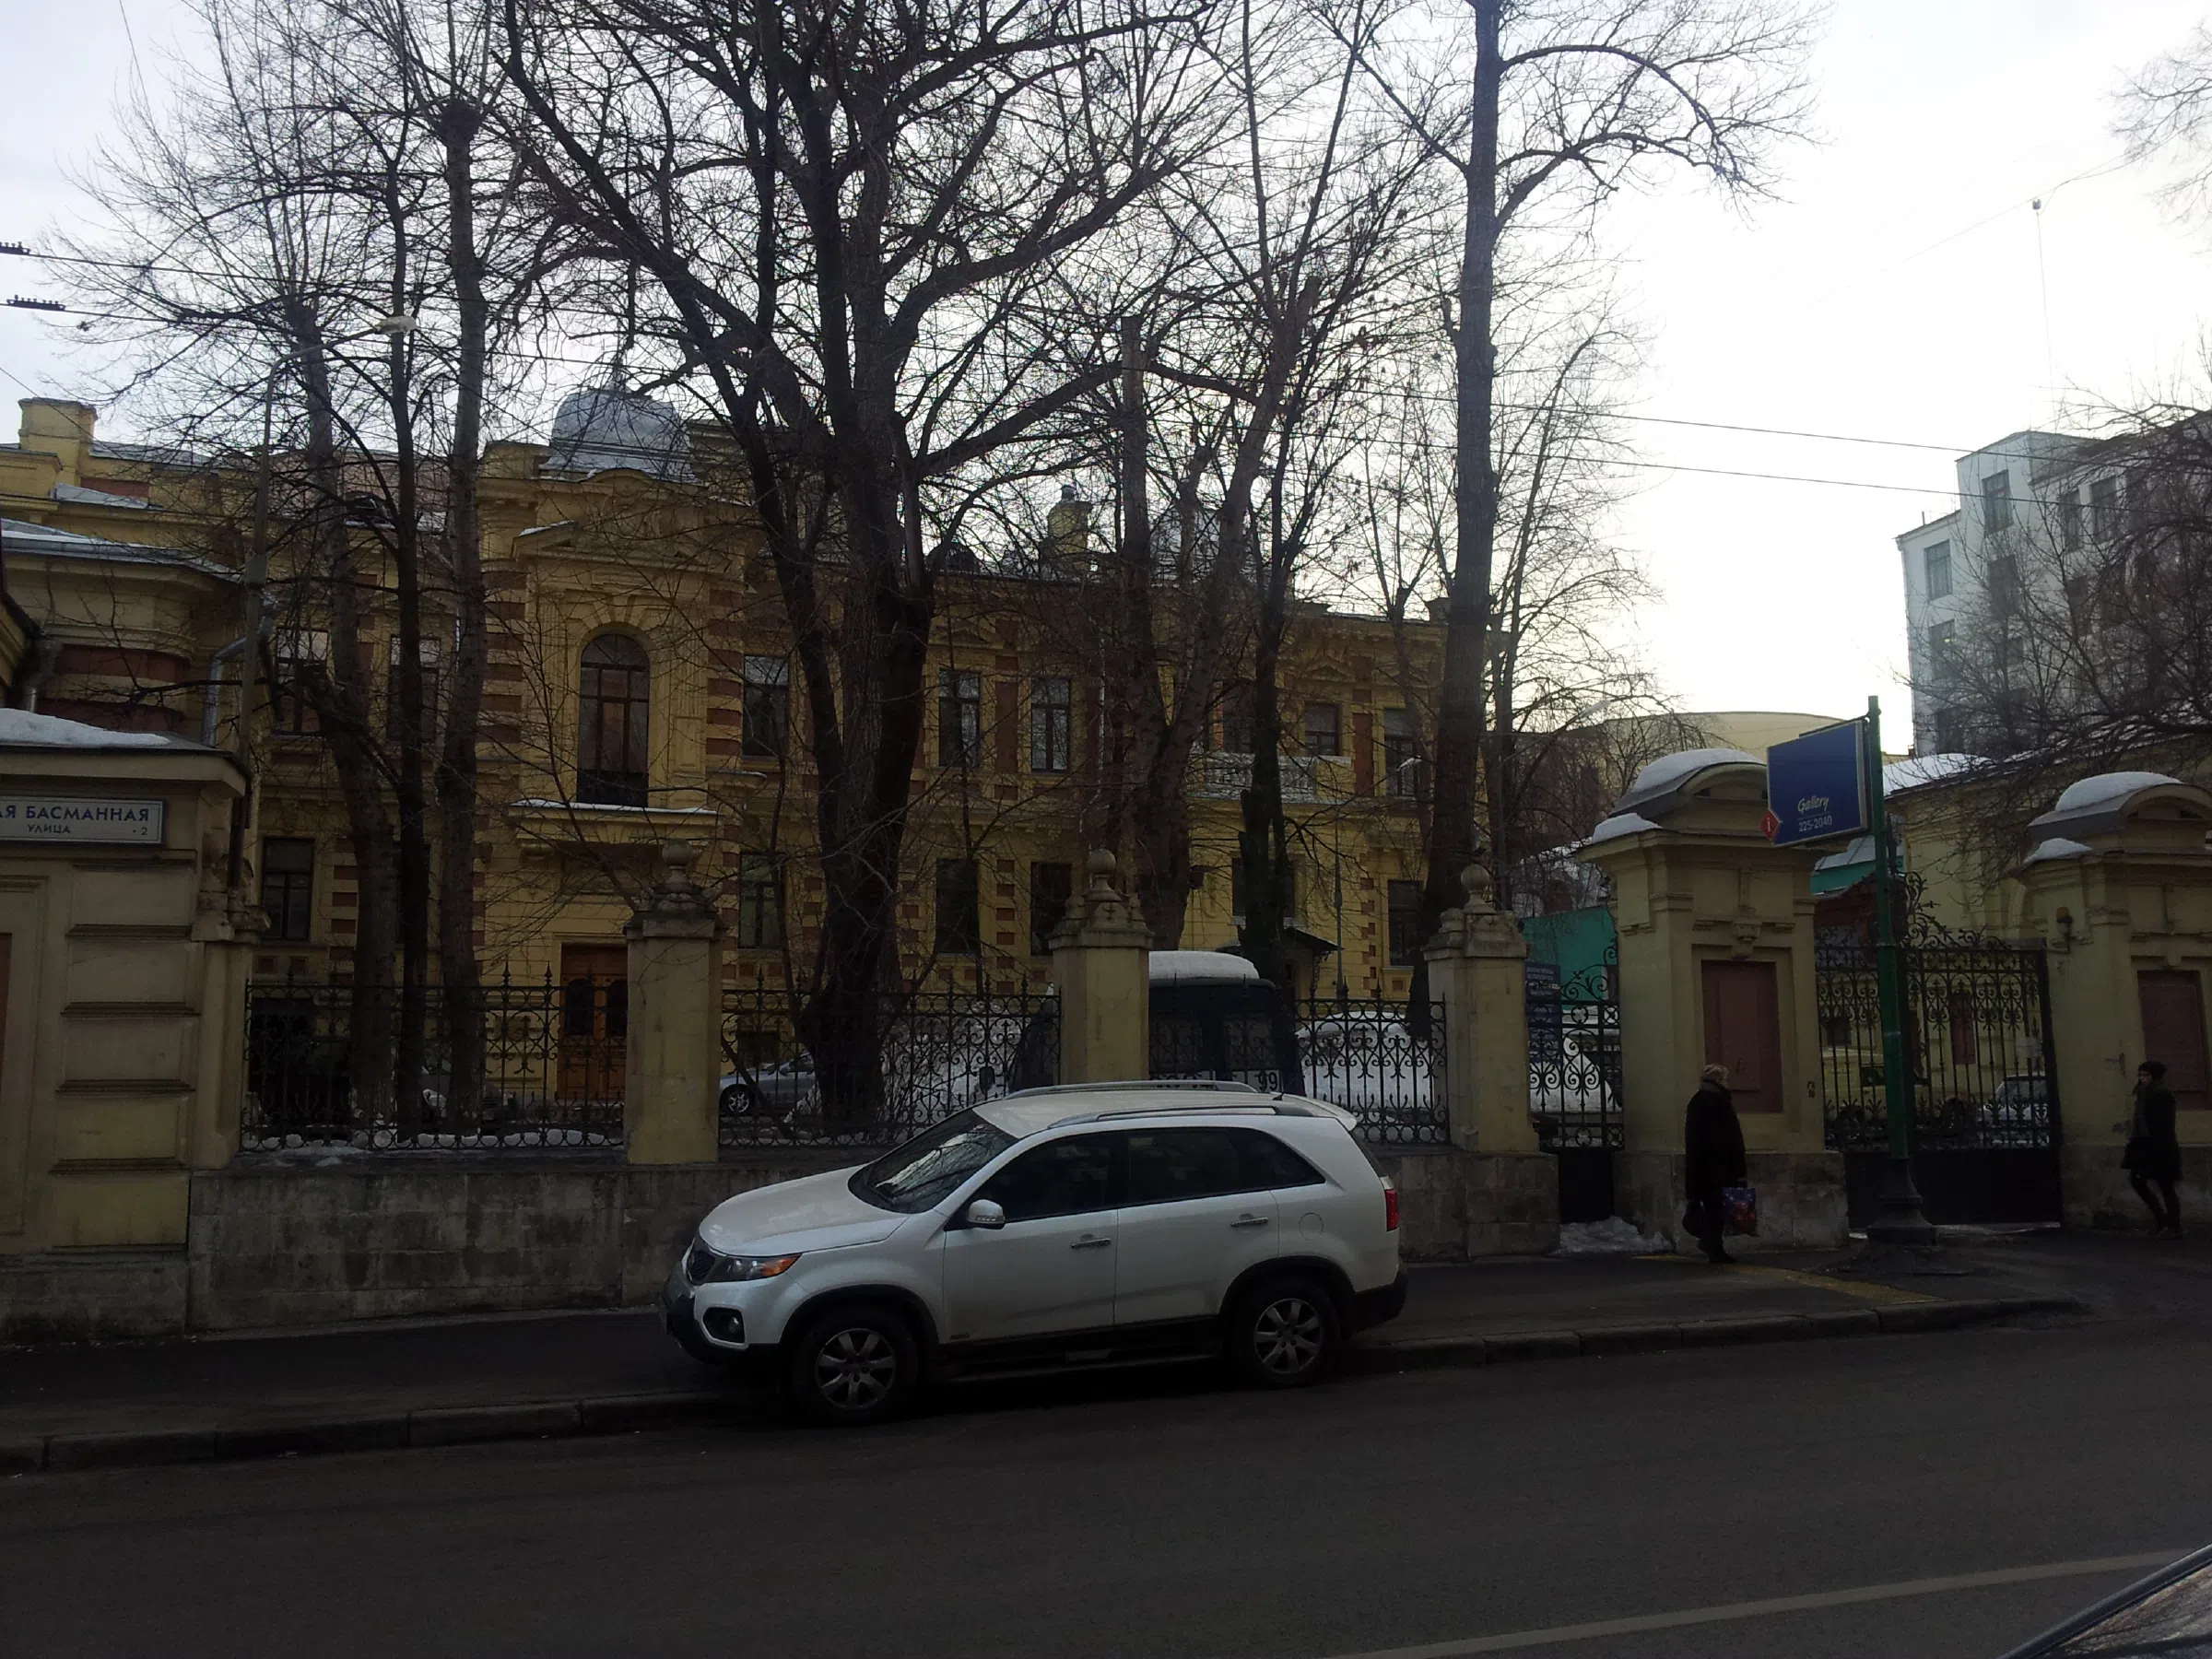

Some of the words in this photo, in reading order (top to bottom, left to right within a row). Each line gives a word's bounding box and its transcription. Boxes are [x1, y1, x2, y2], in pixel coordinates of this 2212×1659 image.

[1797, 794, 1830, 814] Gallery
[0, 805, 16, 818] Я
[26, 806, 149, 821] БАСМАННАЯ
[28, 824, 71, 834] УЛИЦА
[141, 827, 148, 836] 2
[1798, 815, 1833, 832] 225-2040
